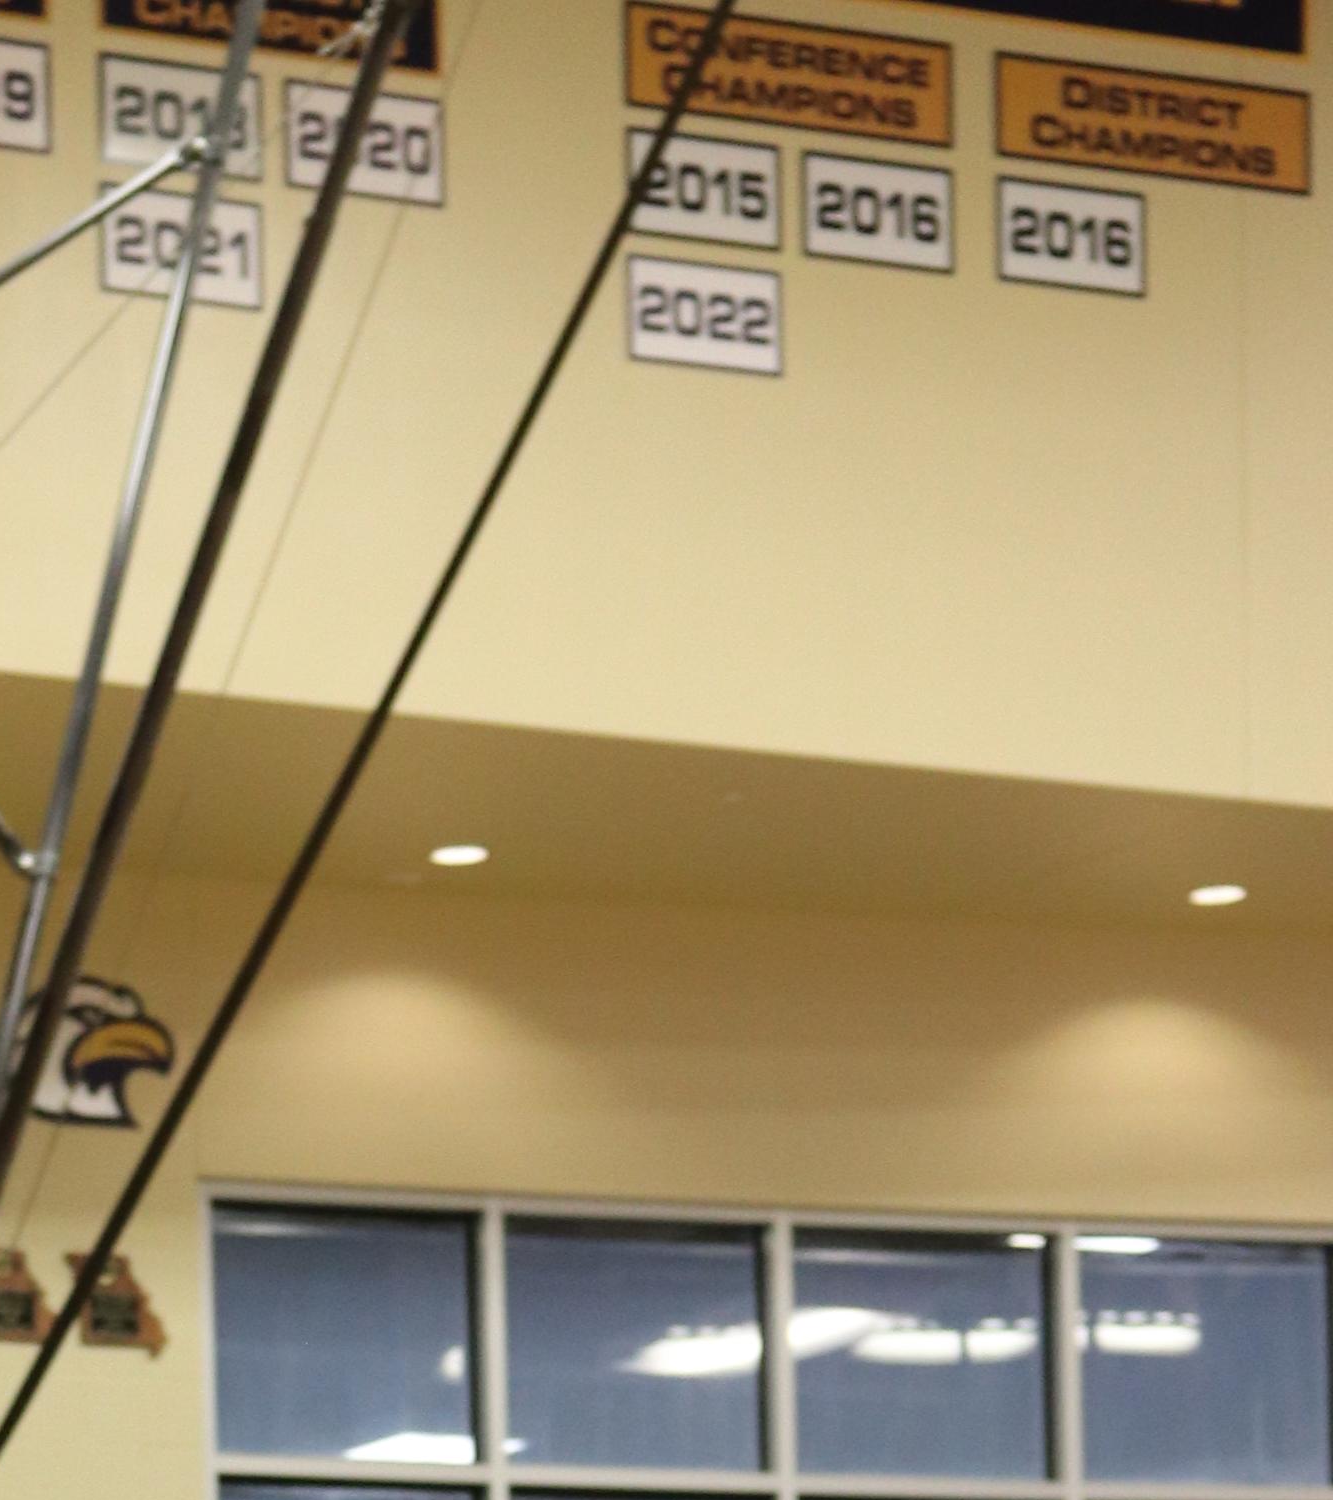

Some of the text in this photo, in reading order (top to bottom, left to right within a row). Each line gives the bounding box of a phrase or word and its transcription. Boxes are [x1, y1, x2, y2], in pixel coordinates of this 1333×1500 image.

[1061, 76, 1245, 131] DISTRICT
[298, 110, 430, 176] 220
[1031, 114, 1276, 177] CHAMPIONS
[641, 163, 767, 220] 2015
[816, 182, 940, 243] 2016
[115, 215, 251, 279] 2021
[1010, 206, 1131, 267] 2016
[639, 284, 771, 346] 2022
